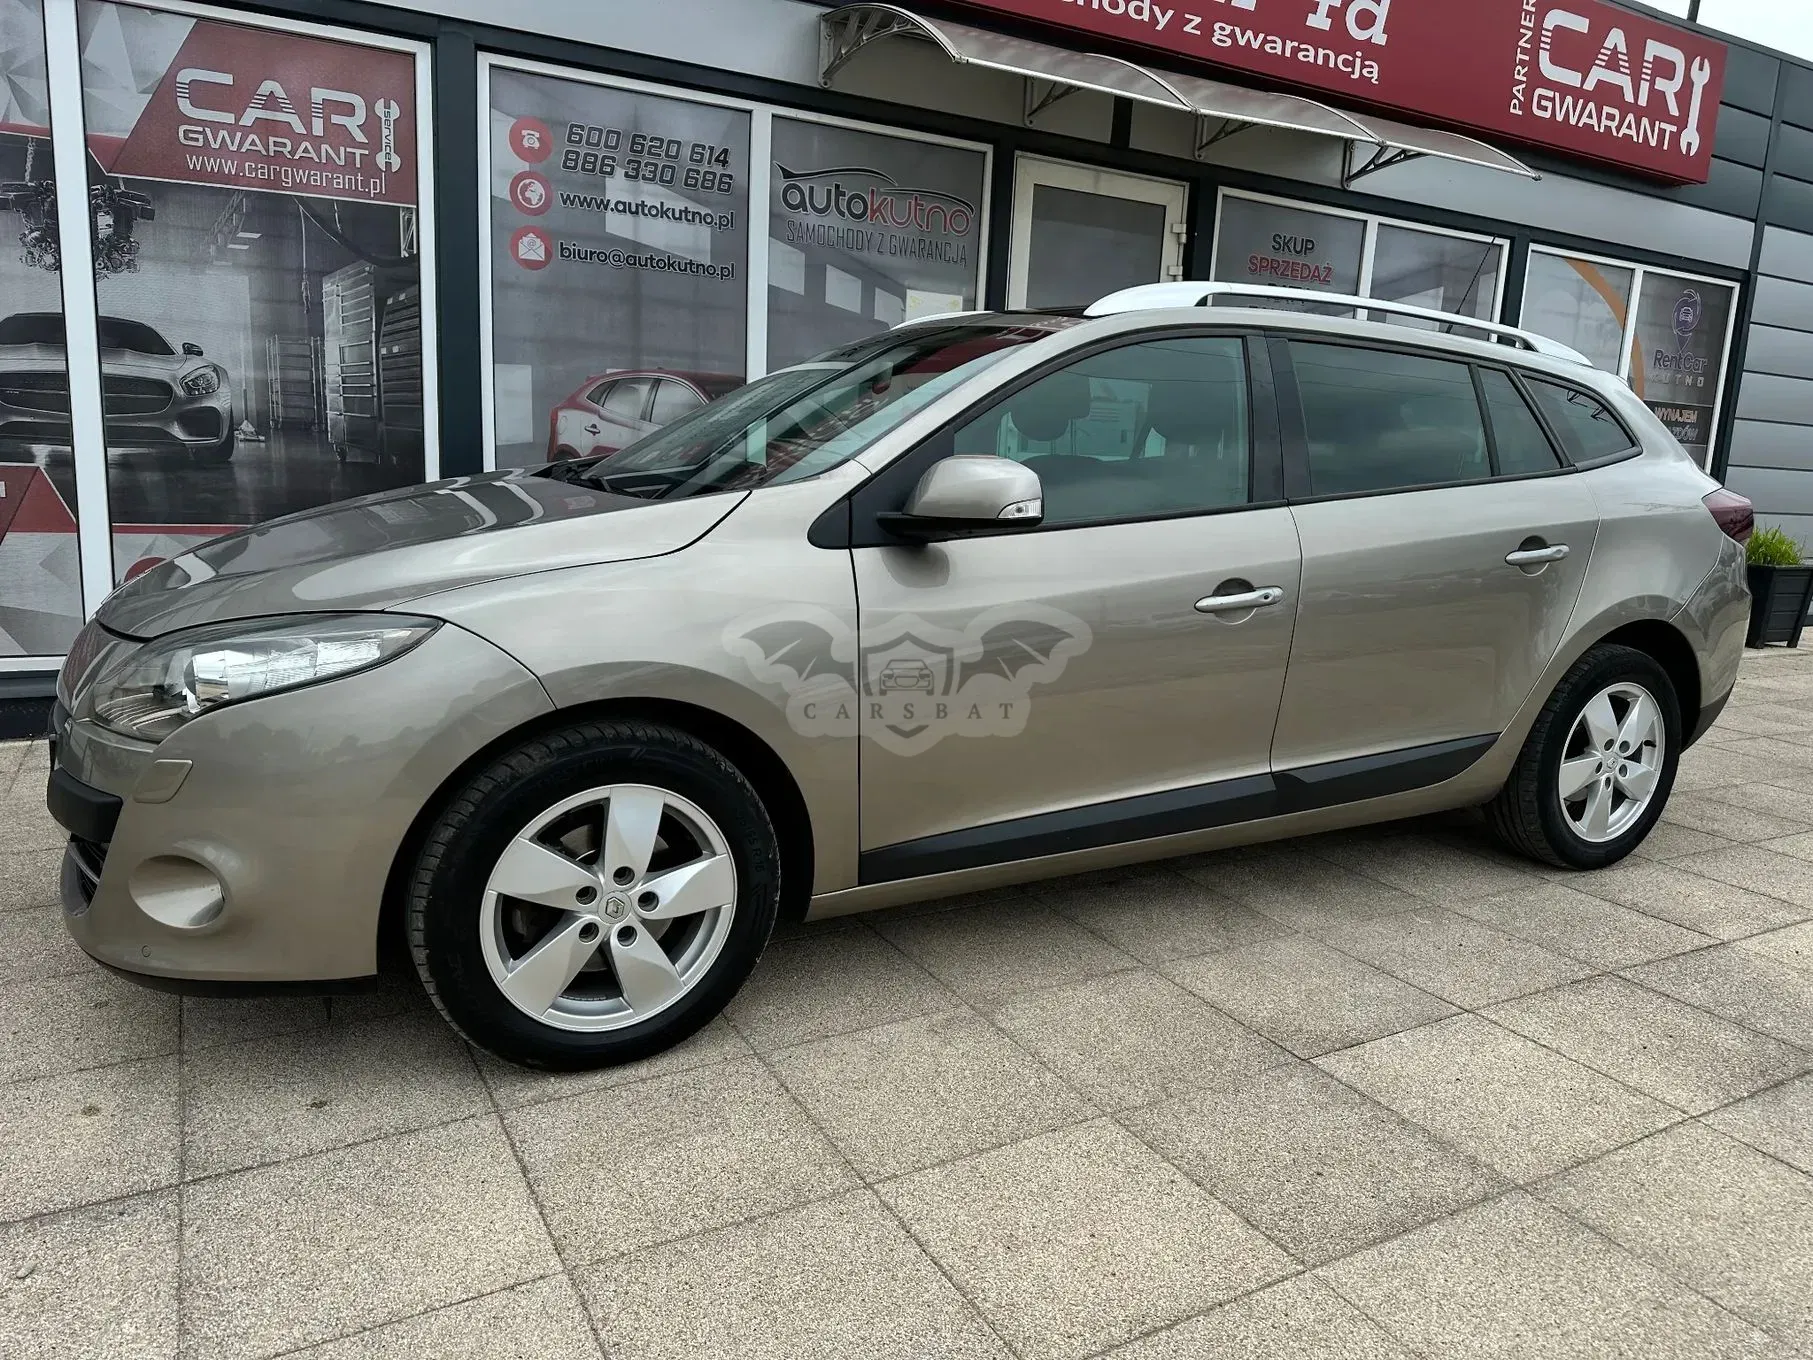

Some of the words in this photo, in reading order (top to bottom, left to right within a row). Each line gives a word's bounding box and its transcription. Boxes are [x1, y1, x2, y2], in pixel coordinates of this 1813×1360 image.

[1183, 13, 1202, 35] z
[1211, 21, 1379, 84] gwarancją
[1510, 0, 1537, 115] PARTNER
[1539, 8, 1679, 117] CAR
[175, 68, 369, 144] CAR
[1531, 87, 1677, 151] GWARANT
[178, 124, 369, 168] GWARANT
[383, 110, 392, 162] service
[566, 122, 622, 151] 600
[629, 132, 683, 161] 620
[688, 141, 730, 168] 614
[186, 154, 386, 197] www.cargwarant.pl
[561, 149, 617, 176] 886
[624, 158, 676, 186] 330
[683, 167, 734, 195] 686
[559, 191, 734, 230] www.autokutno.pl
[781, 181, 971, 236] autokutno
[559, 242, 735, 280] biuro@autokutno.pl
[787, 219, 873, 251] SAMOCHODY
[876, 233, 885, 255] Z
[889, 234, 967, 268] GWARANCJĄ
[1271, 233, 1315, 256] SKUP
[1248, 254, 1334, 284] SPRZEDAŻ
[1655, 406, 1698, 424] WYNAJEM
